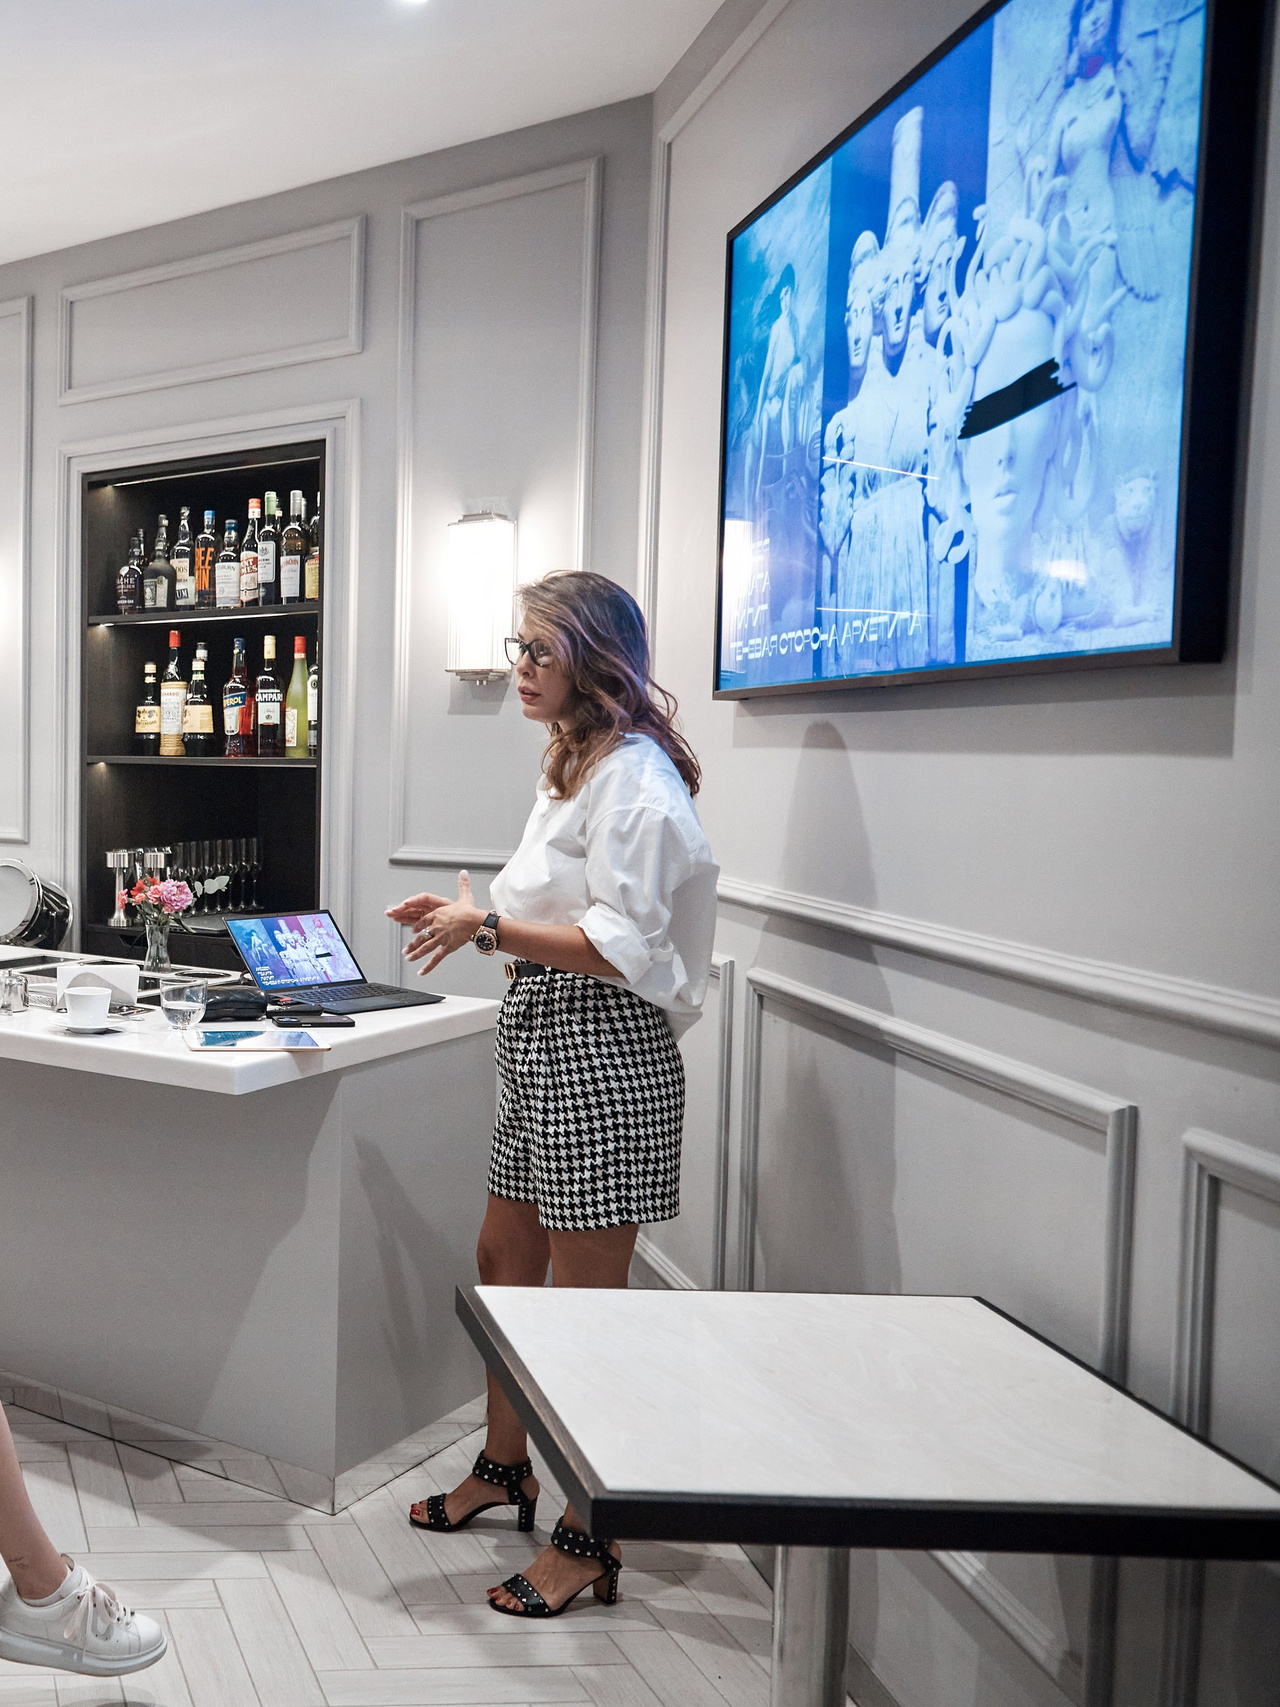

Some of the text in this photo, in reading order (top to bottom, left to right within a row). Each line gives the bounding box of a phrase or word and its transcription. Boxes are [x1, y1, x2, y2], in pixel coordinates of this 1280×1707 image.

[730, 609, 923, 662] ТЕНЕВАЯ СТОРОНА АРХЕТИПА
[255, 693, 283, 702] CAMPARI
